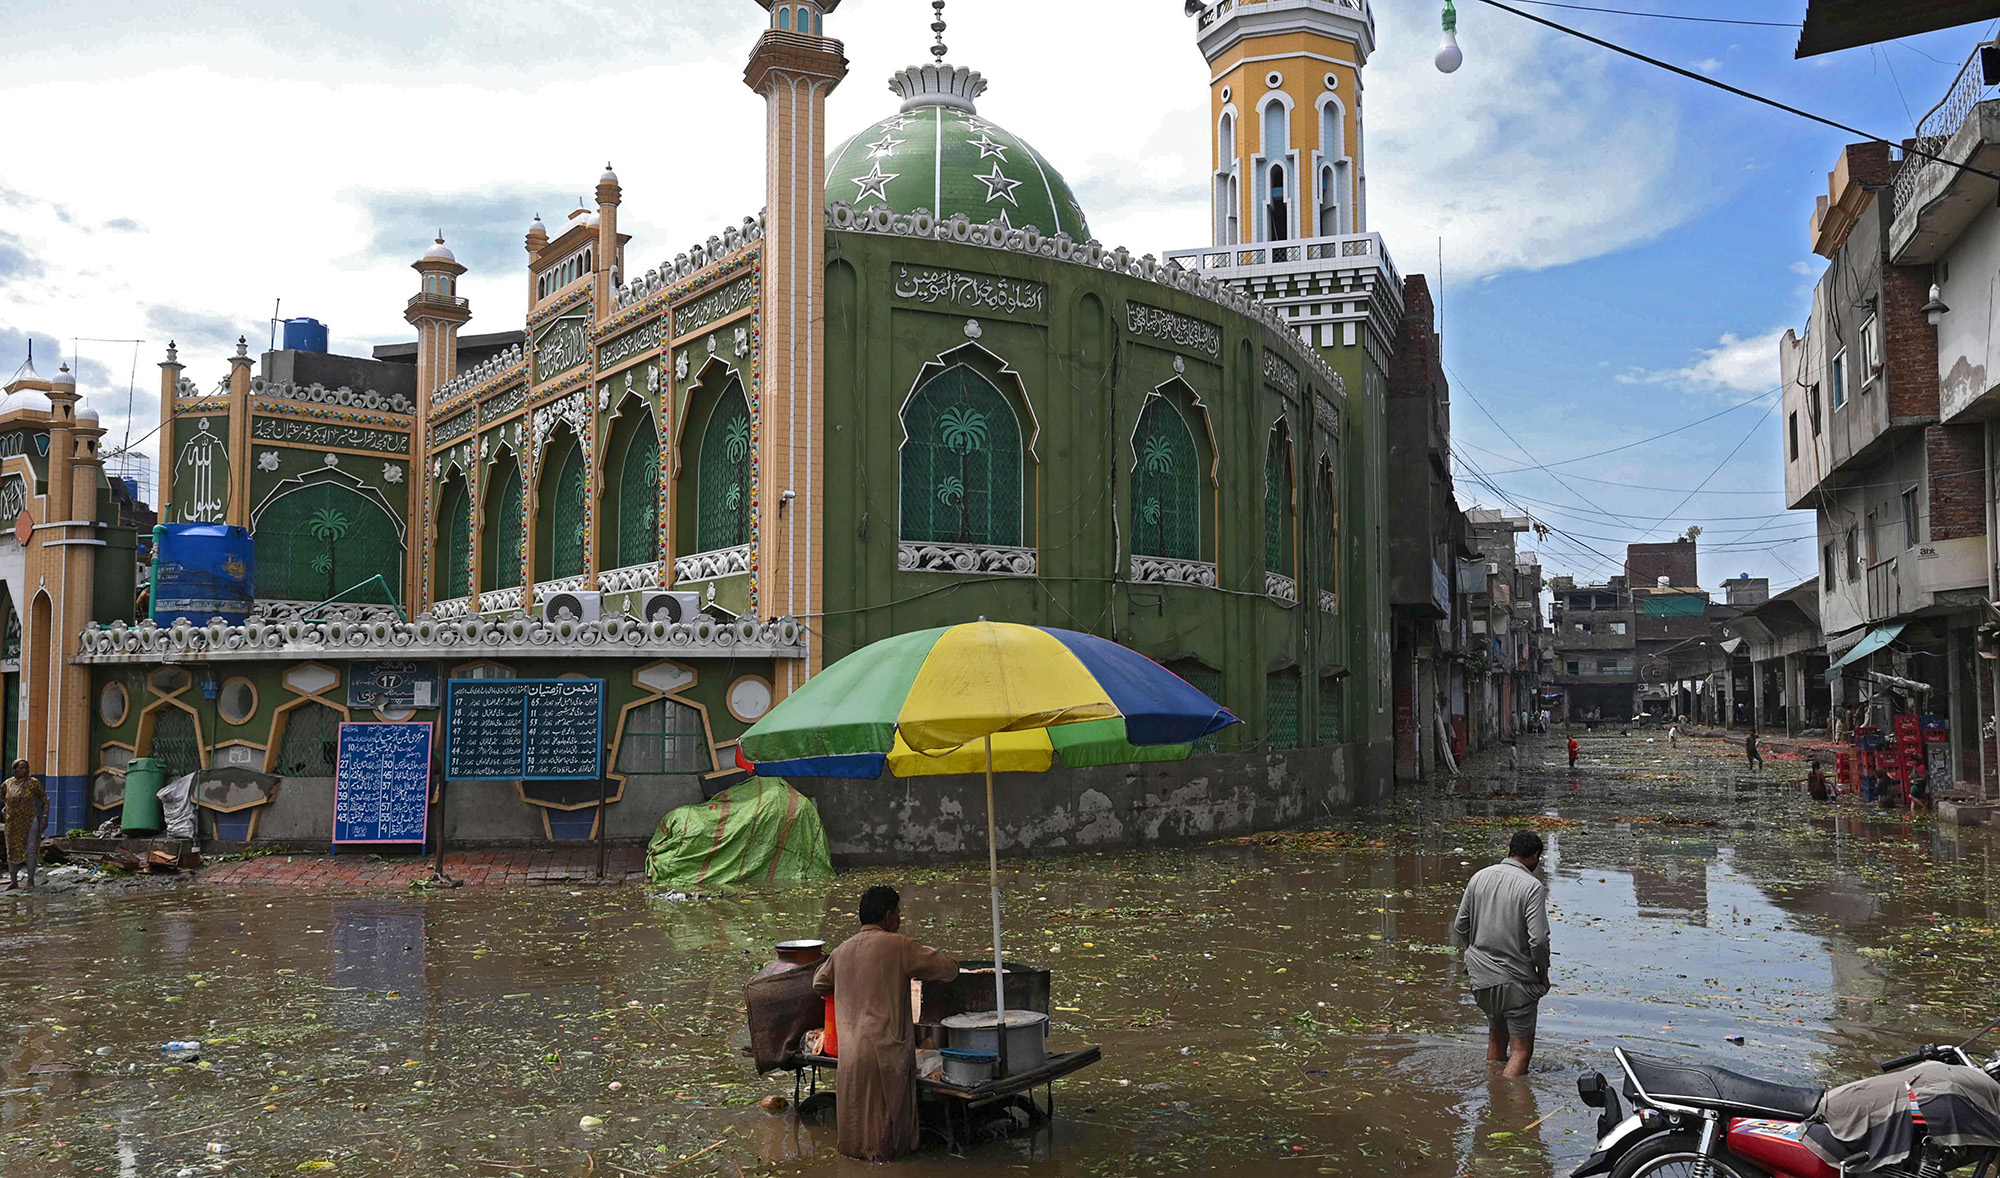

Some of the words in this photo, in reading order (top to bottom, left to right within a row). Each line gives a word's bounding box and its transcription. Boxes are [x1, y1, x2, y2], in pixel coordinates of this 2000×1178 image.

[382, 675, 396, 687] 17
[340, 760, 349, 768] 27
[384, 760, 393, 768] 30
[340, 770, 349, 779] 46
[338, 781, 348, 790] 30
[382, 782, 391, 790] 37
[338, 792, 348, 800] 39
[337, 802, 347, 811] 63
[382, 802, 390, 811] 57
[337, 813, 347, 822] 43
[381, 813, 390, 822] 53
[381, 824, 387, 833] 4
